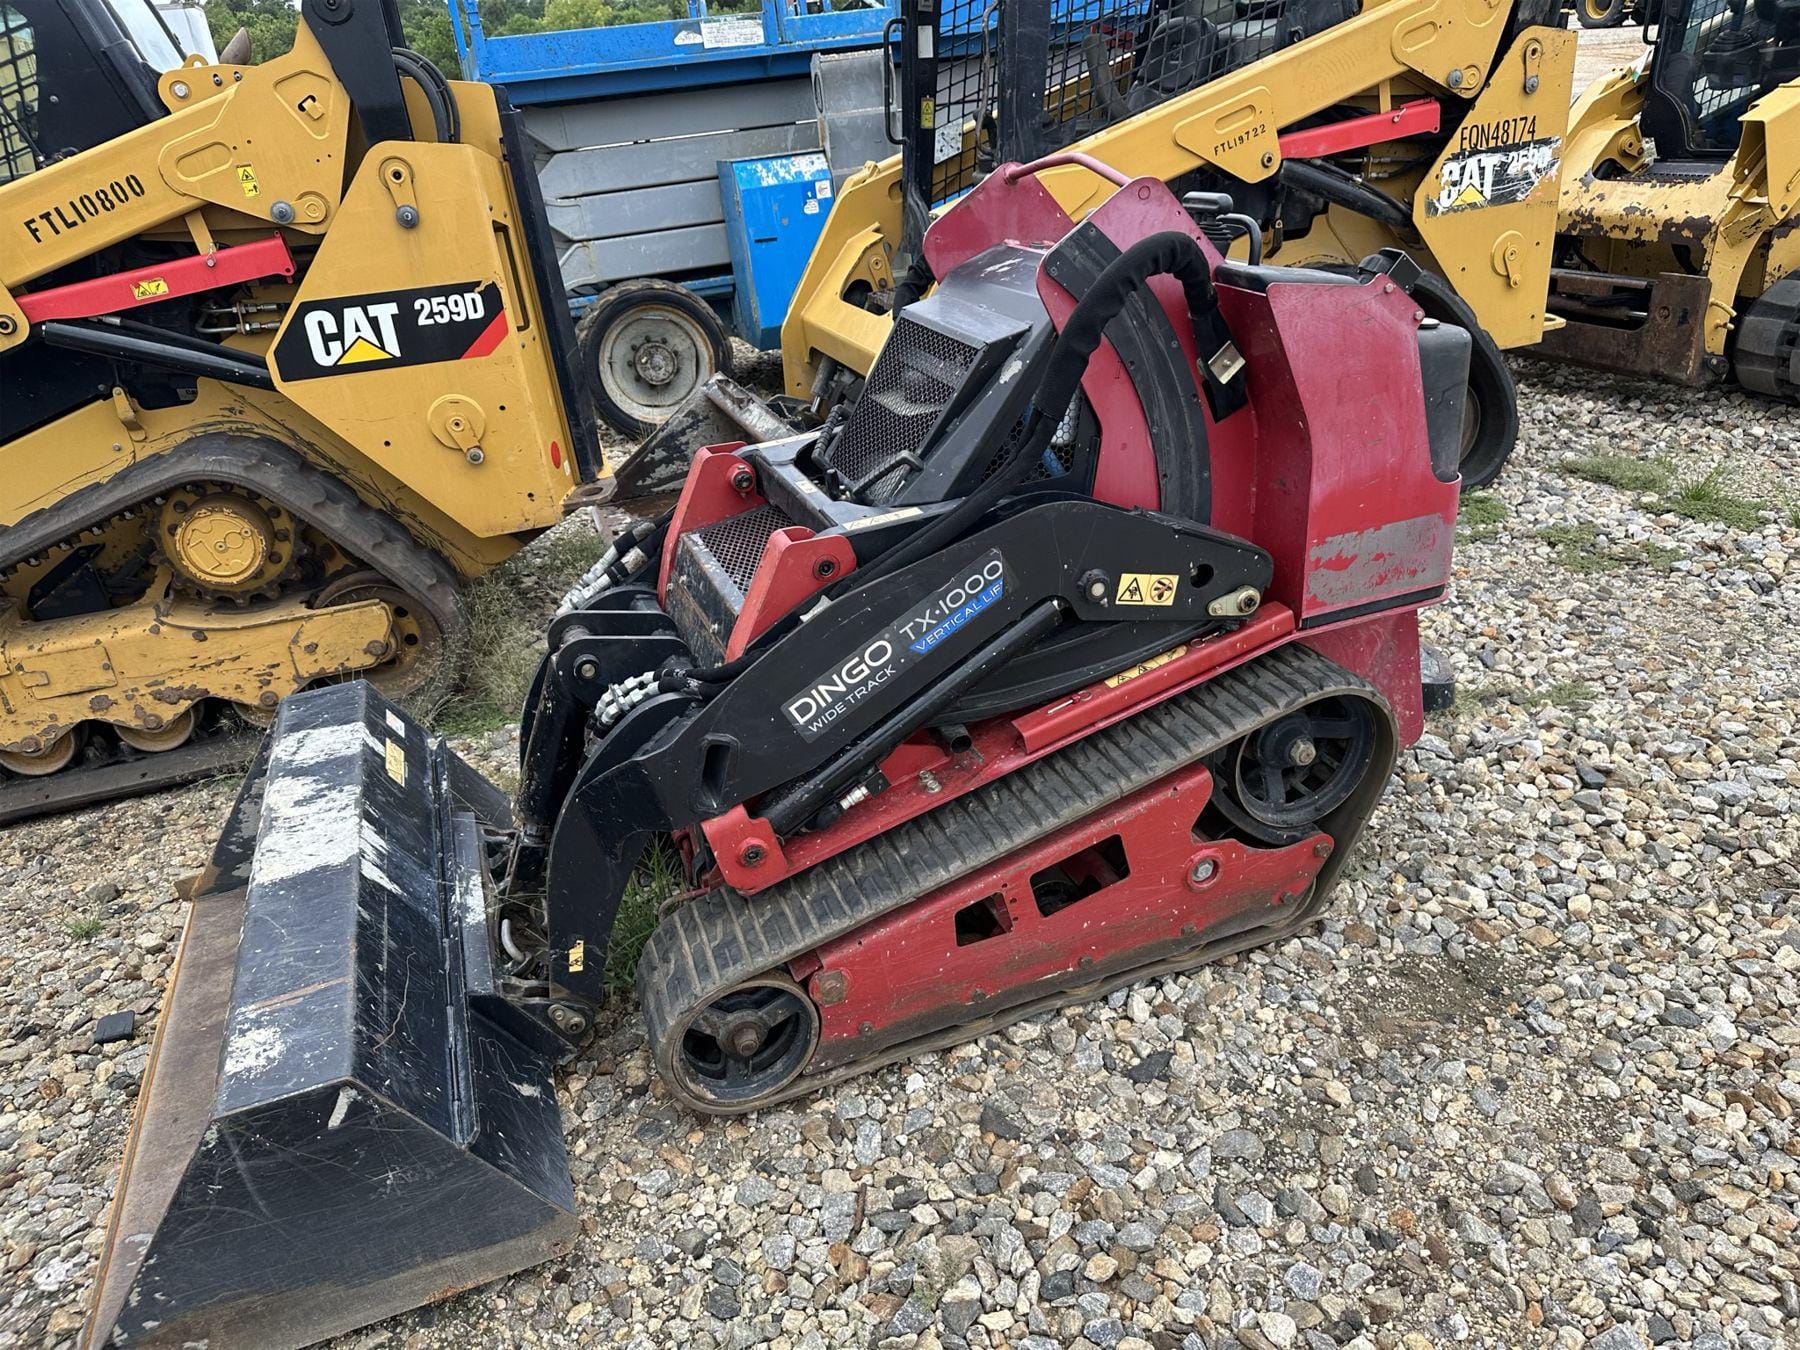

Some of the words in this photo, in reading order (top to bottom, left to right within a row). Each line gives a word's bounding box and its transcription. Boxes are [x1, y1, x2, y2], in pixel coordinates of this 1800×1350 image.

[1460, 115, 1536, 151] EQN48174
[1440, 154, 1500, 208] CAT
[304, 302, 401, 367] CAT
[413, 292, 485, 326] 259D
[915, 601, 982, 650] VERTICAL
[982, 581, 1003, 604] LIF
[788, 640, 892, 725] DINGO
[808, 701, 847, 732] WIDE
[845, 664, 897, 704] TRACK
